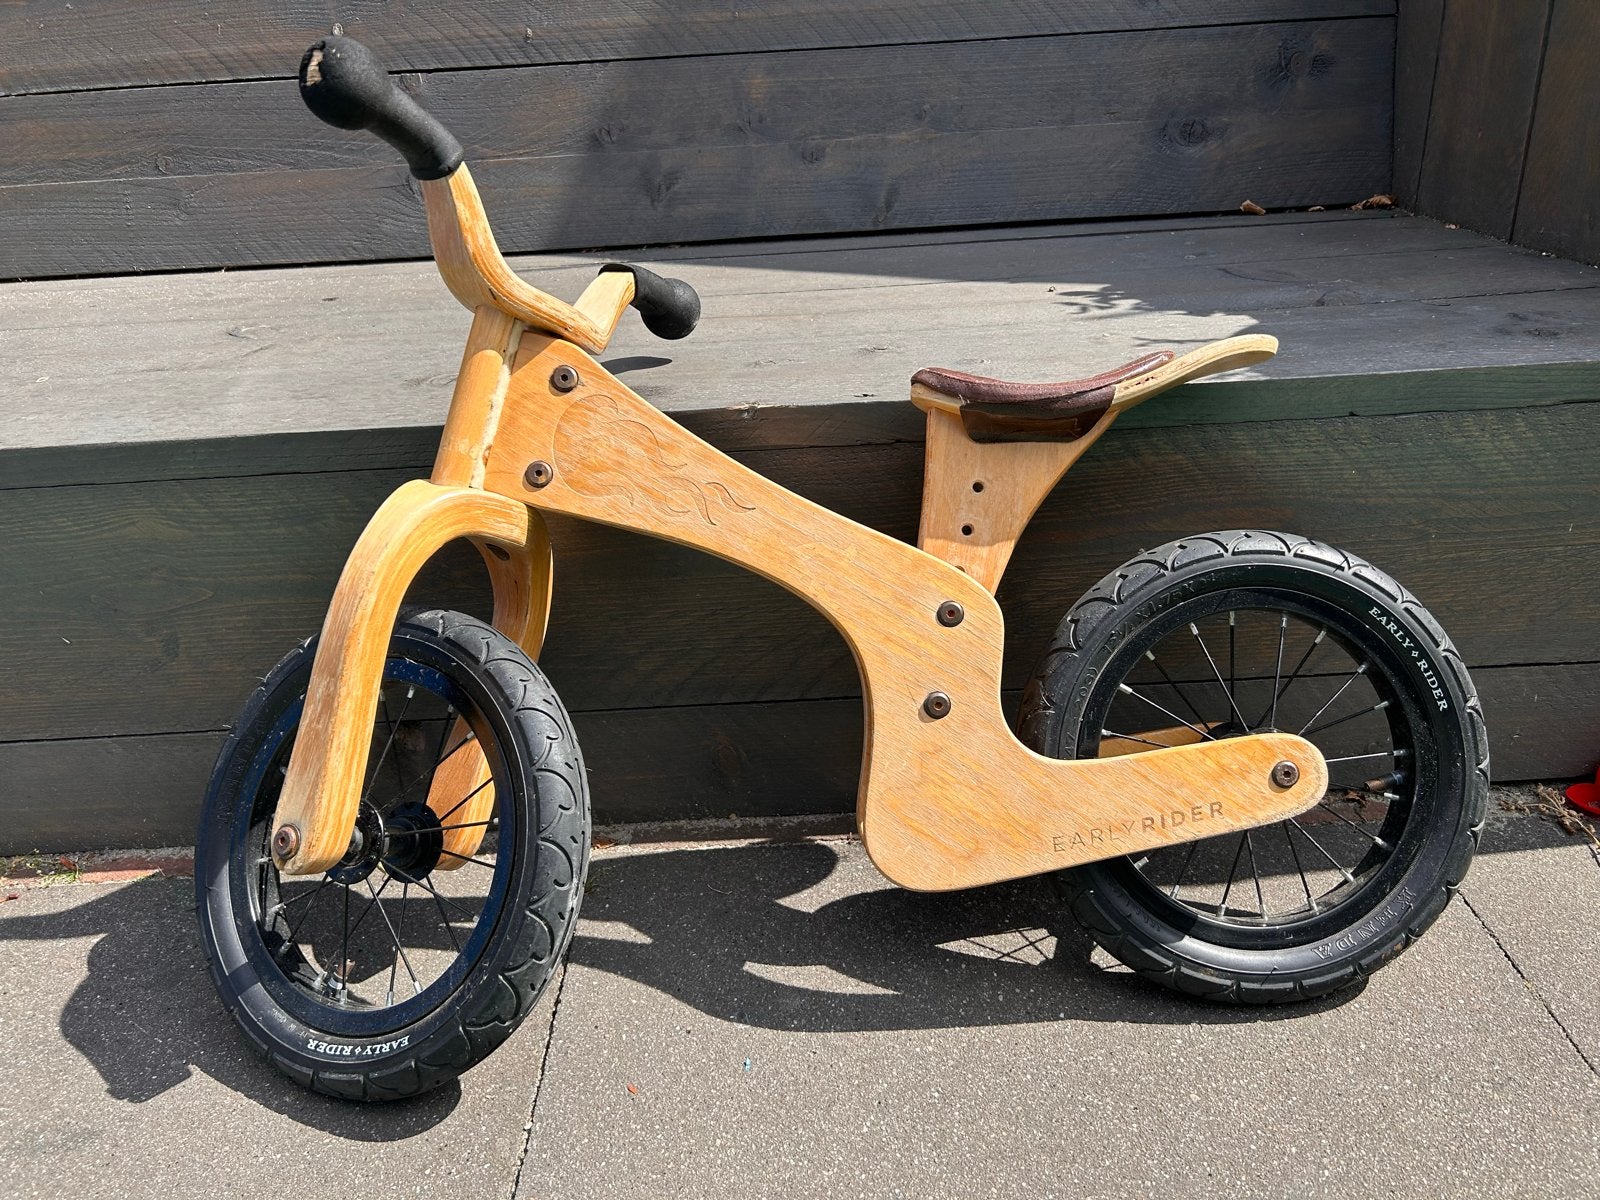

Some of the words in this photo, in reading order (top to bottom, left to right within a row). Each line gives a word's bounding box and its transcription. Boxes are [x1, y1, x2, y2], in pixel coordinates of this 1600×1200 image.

[1368, 606, 1414, 648] EARLY
[1416, 659, 1448, 712] RIDER
[1311, 886, 1417, 960] KENDA
[307, 1038, 352, 1056] RIDER
[362, 1035, 411, 1055] EARLY
